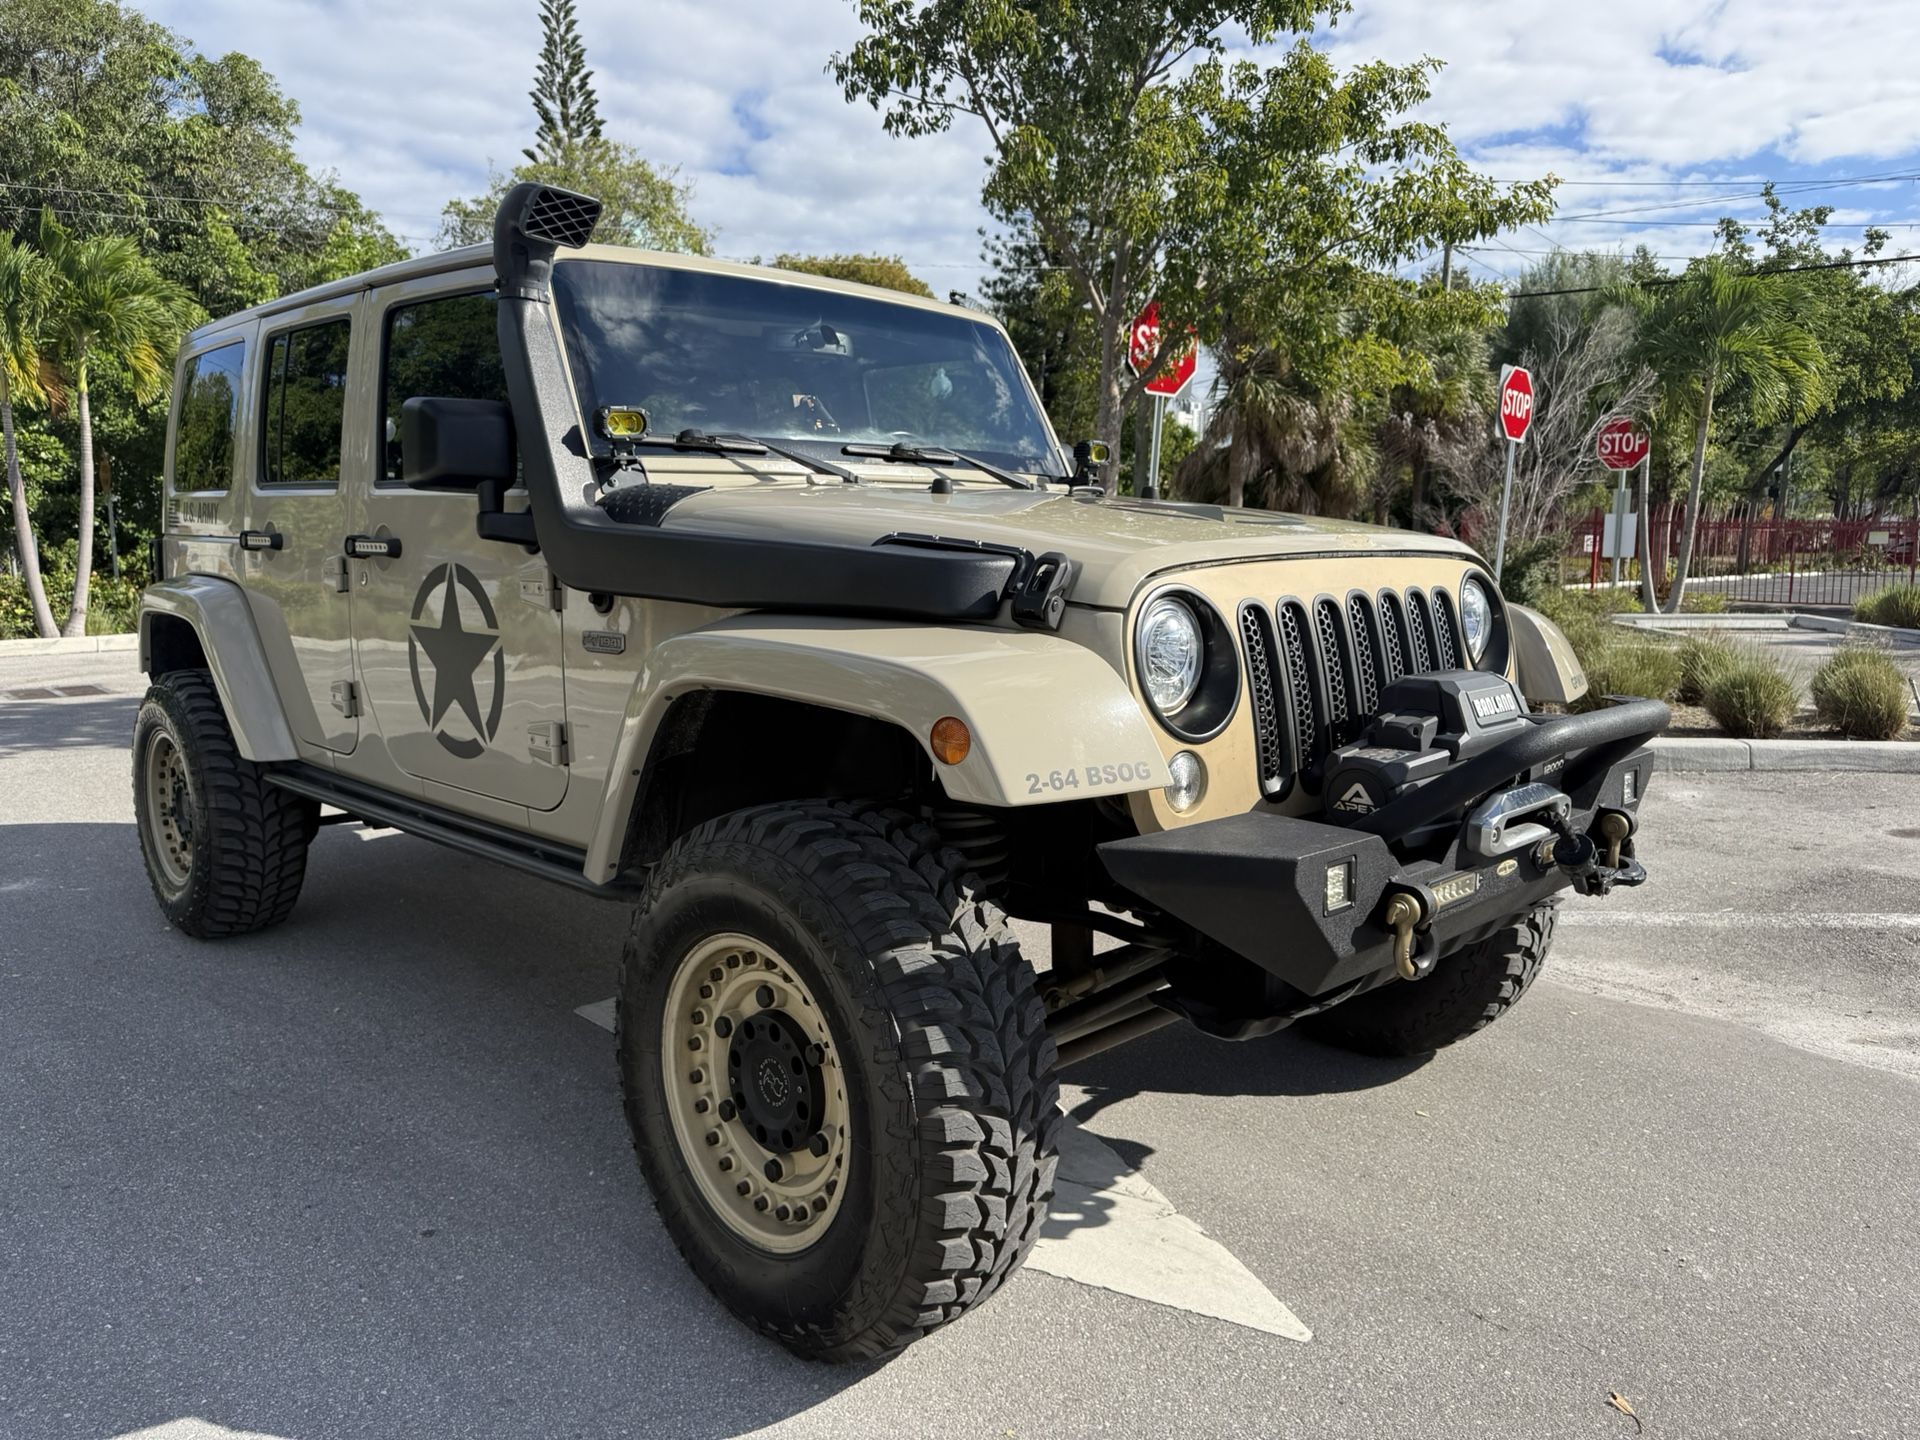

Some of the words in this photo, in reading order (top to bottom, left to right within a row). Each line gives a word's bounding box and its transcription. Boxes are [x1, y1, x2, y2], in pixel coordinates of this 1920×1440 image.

[1503, 388, 1532, 419] STOP
[1600, 432, 1646, 454] STOP
[182, 502, 195, 522] U.S.
[196, 502, 219, 525] ARMY
[1473, 692, 1516, 718] BADLAND
[1025, 768, 1080, 794] 2-64
[1085, 761, 1151, 786] BSOG
